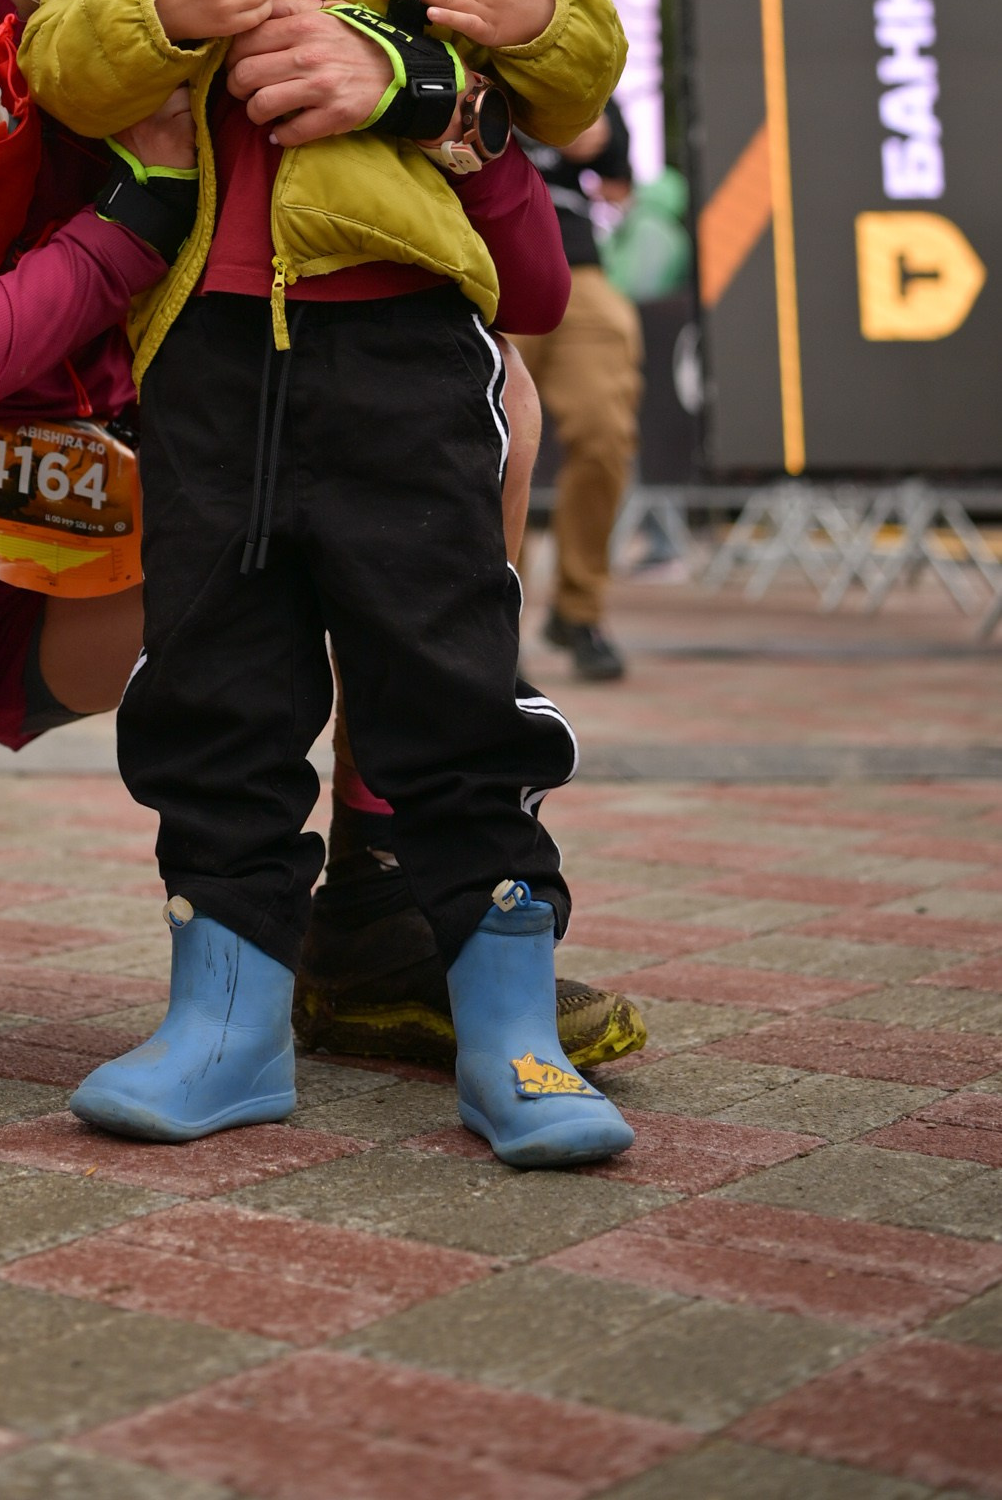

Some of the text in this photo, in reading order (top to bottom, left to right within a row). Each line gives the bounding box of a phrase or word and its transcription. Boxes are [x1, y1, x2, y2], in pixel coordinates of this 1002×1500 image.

[352, 9, 414, 43] LEKI
[16, 425, 106, 456] ABISHIRA 40
